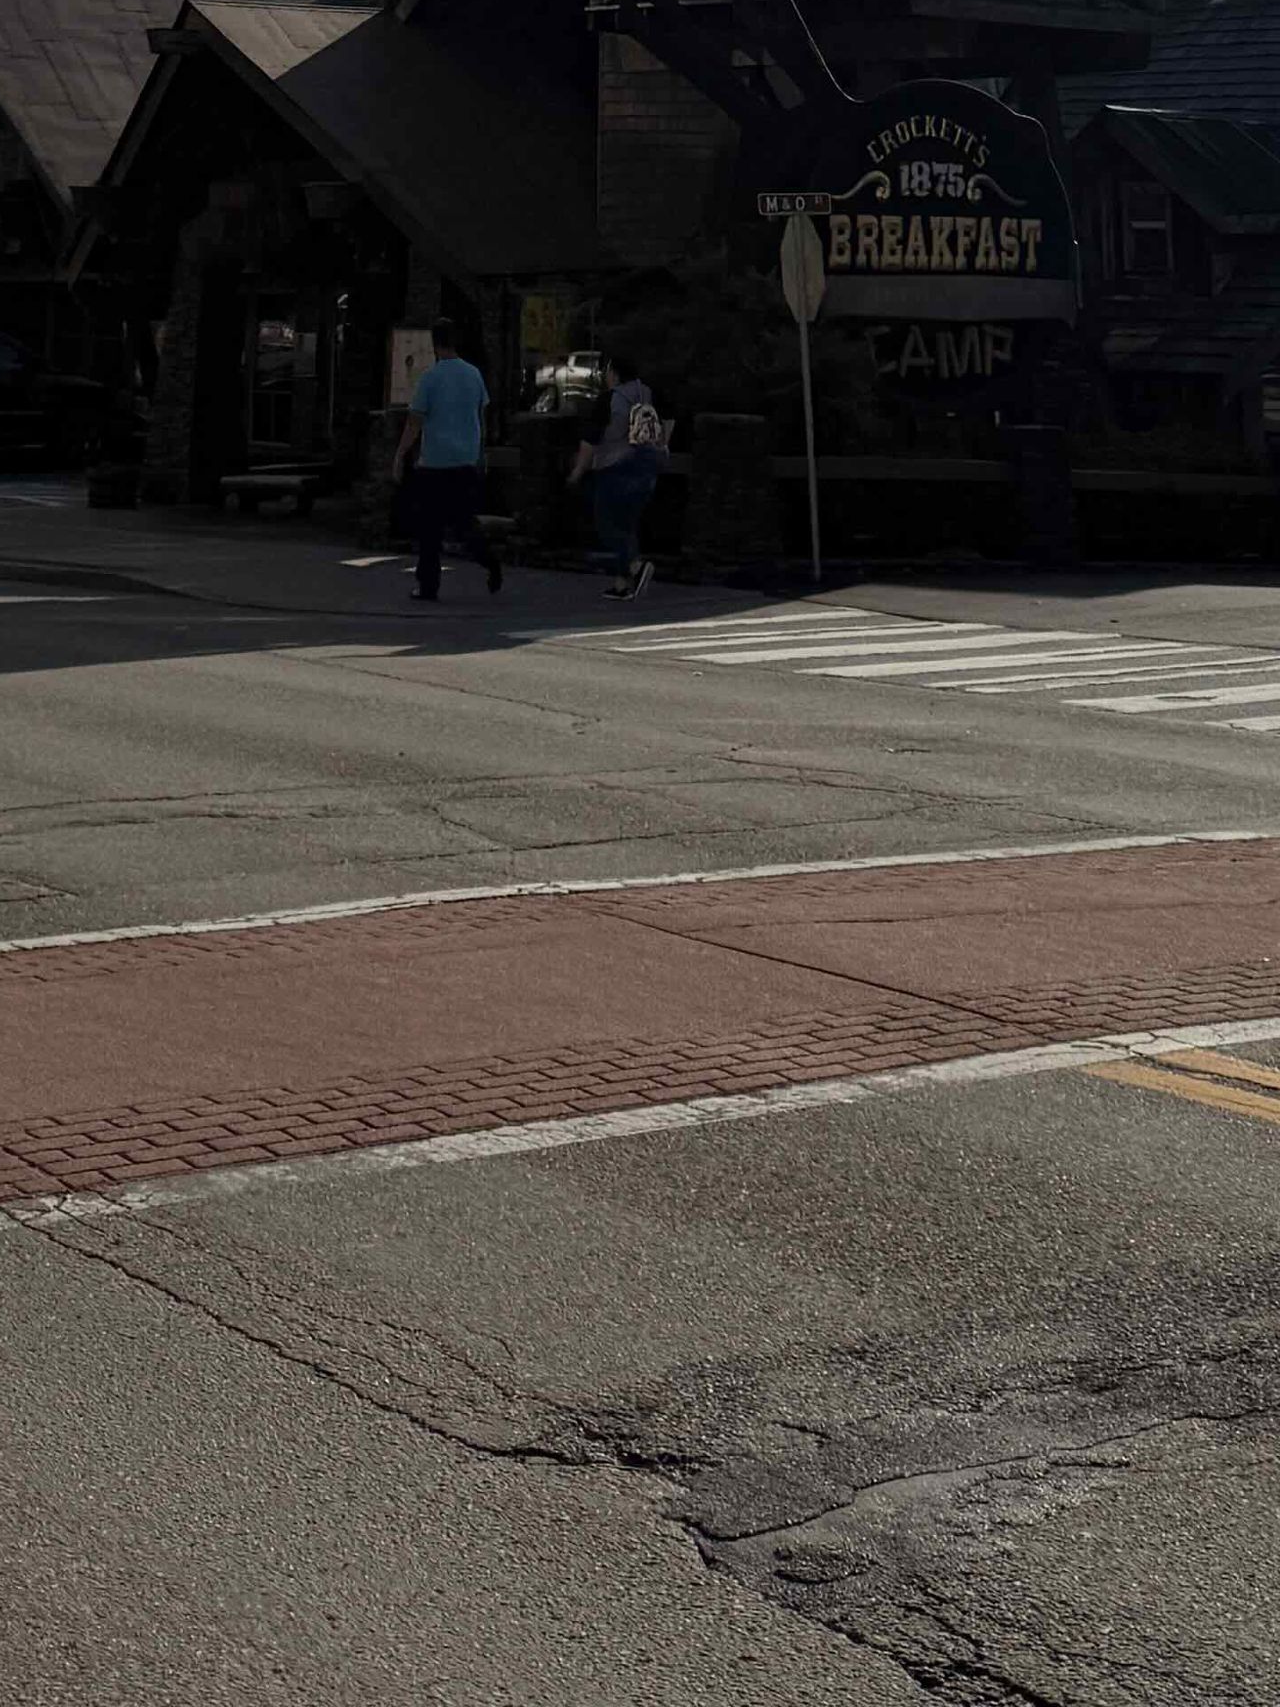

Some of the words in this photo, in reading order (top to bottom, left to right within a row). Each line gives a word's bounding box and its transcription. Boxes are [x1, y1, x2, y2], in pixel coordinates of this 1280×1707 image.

[867, 114, 992, 169] CROCKETT'S
[898, 160, 967, 200] 1875
[827, 213, 1044, 275] BREAKFAST
[864, 322, 1016, 380] CAMP
